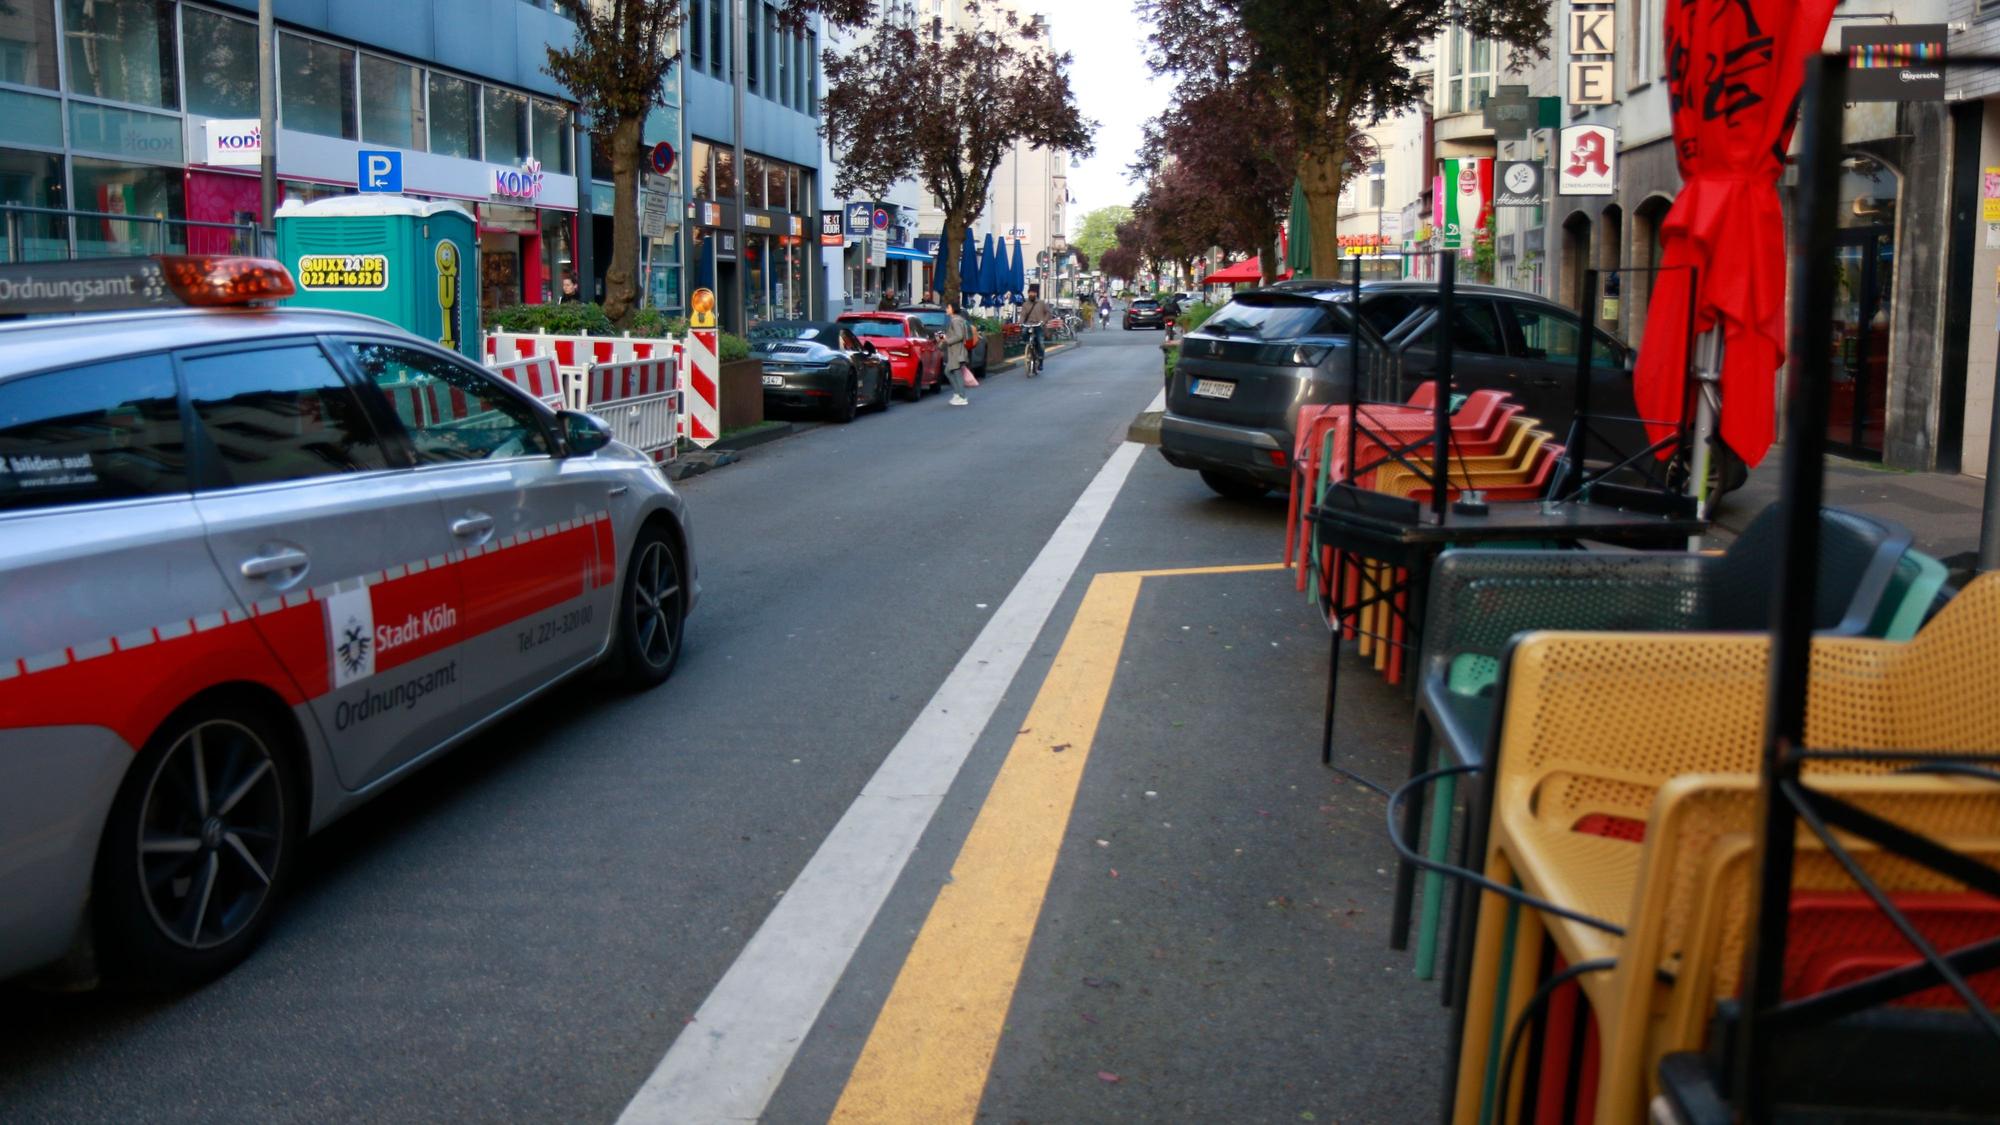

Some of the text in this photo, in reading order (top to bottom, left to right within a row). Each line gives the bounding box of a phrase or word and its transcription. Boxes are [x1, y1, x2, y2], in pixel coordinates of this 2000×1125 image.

[368, 155, 392, 187] P
[823, 214, 840, 224] NEXT
[823, 224, 840, 234] DOOR
[301, 257, 383, 272] QUIXX24.DE
[0, 276, 136, 303] Ordnungsamt
[376, 603, 457, 652] Stadt Köln
[516, 629, 536, 653] Tel.
[334, 660, 457, 732] Ordnungsamt
